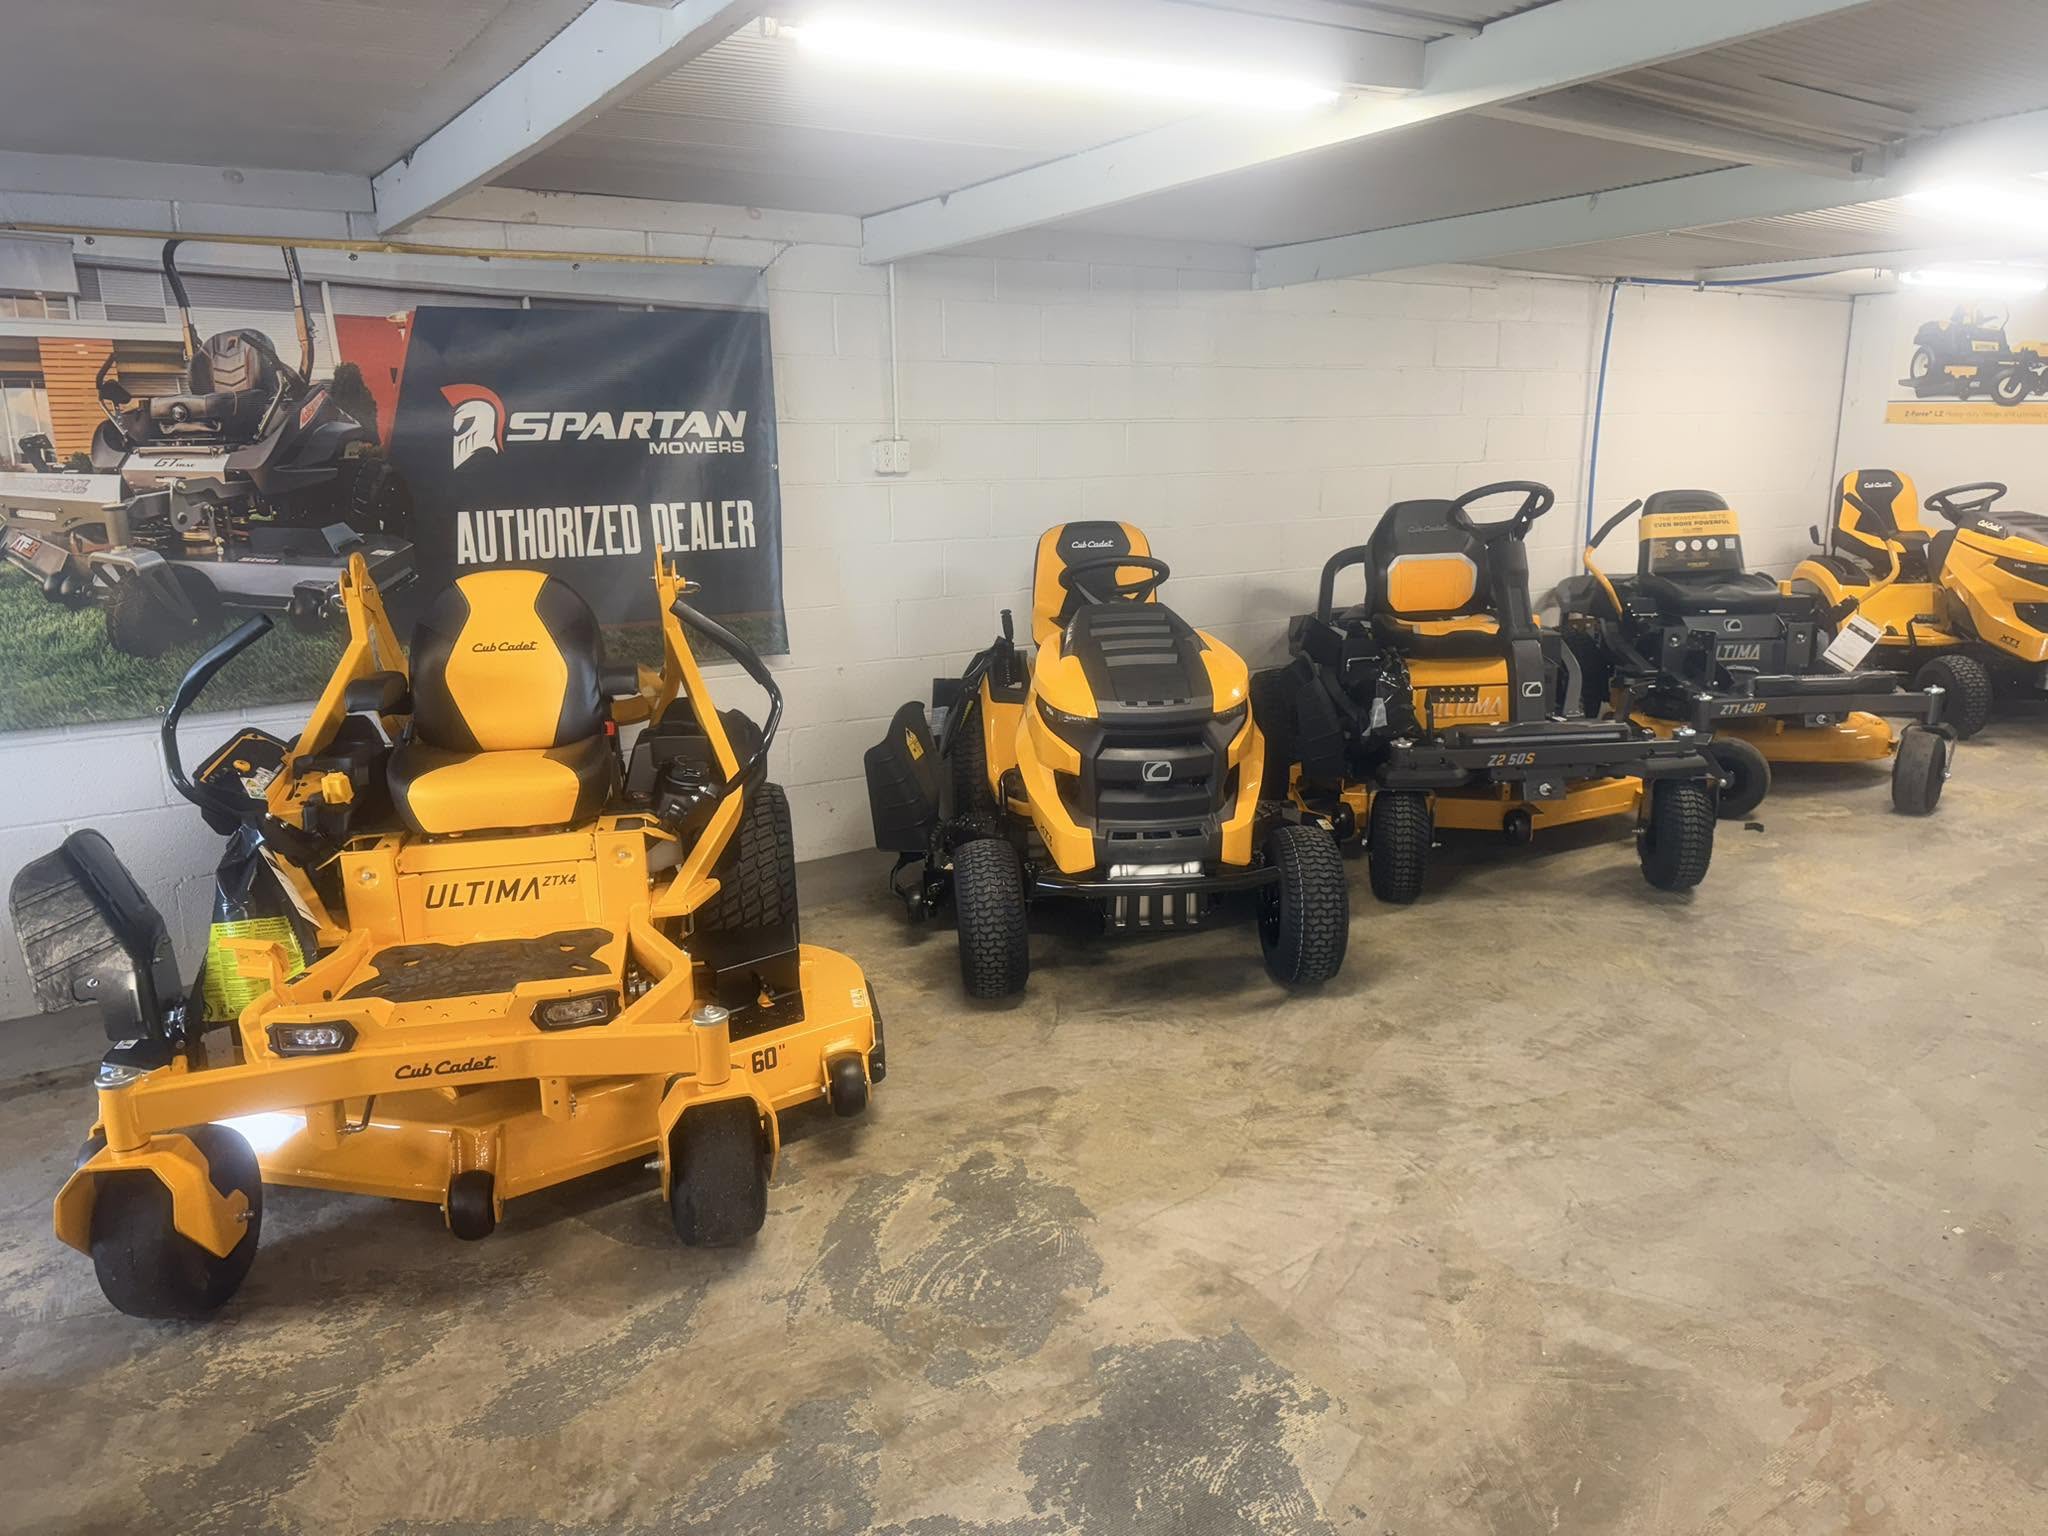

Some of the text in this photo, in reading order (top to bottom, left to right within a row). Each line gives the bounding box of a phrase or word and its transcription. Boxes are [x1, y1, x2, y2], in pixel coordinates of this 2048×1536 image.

[506, 410, 747, 442] SPARTAN
[649, 440, 746, 455] MOWERS
[457, 500, 757, 565] AUTHORIZED DEALER
[1071, 540, 1115, 549] Cub Cadet
[472, 641, 538, 653] Cub Cadet
[1715, 644, 1760, 660] LTIMA
[1487, 751, 1536, 767] Z2 50S
[425, 873, 577, 909] ULTIMA ZTX4
[395, 1055, 497, 1080] Cub Cadet
[751, 1043, 786, 1074] 60"
